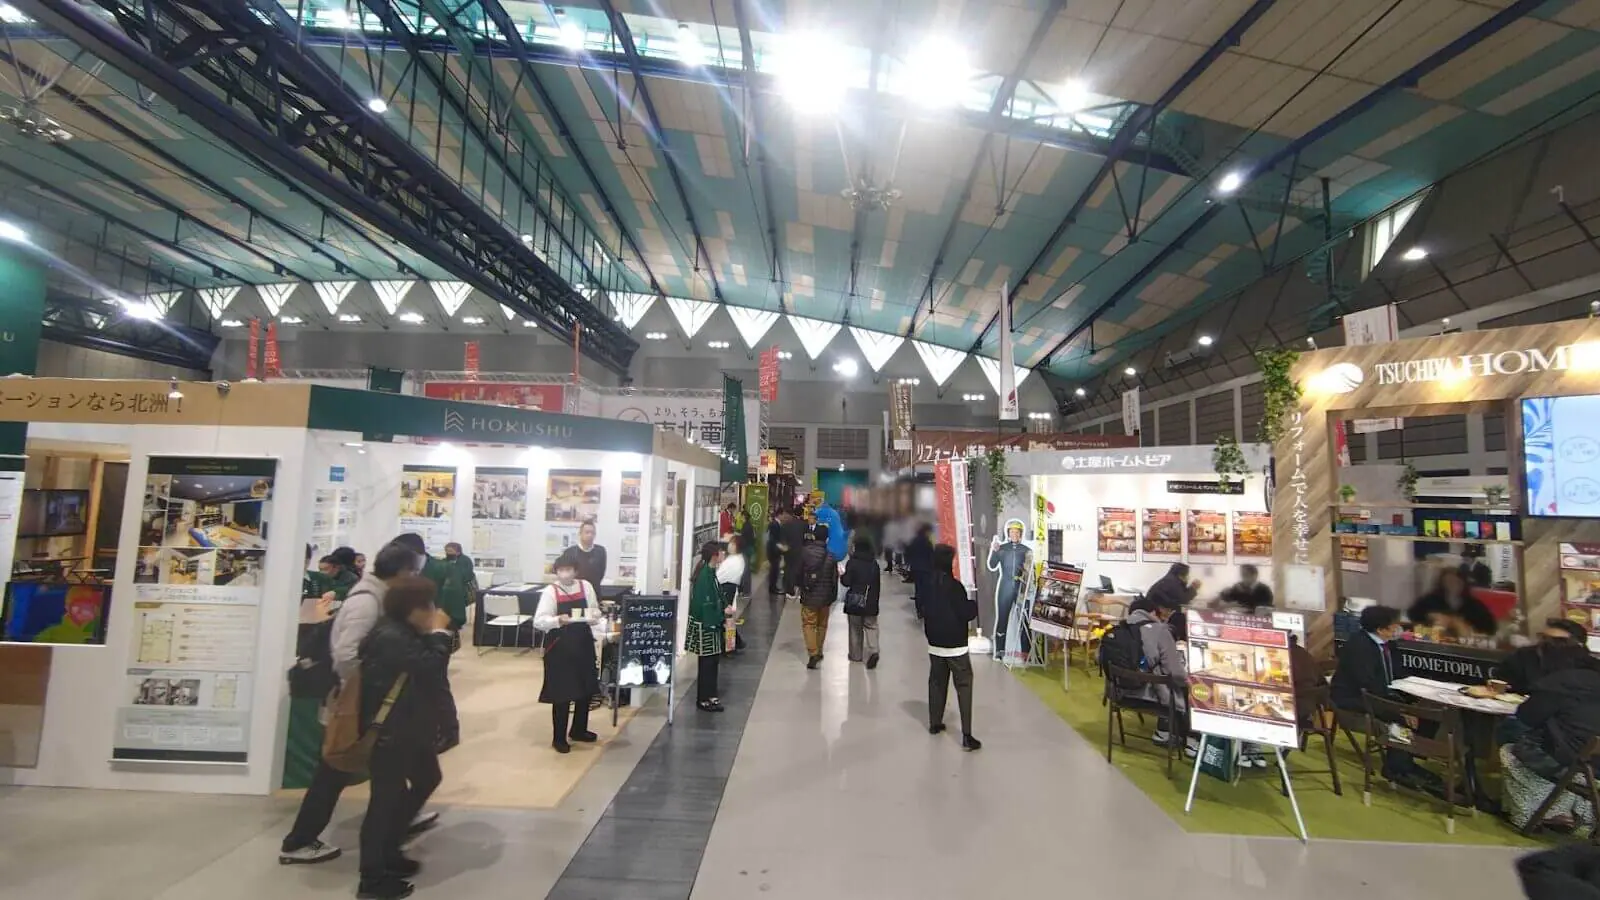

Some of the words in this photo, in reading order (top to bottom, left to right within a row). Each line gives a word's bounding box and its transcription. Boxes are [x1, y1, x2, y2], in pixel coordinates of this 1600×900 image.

[1374, 356, 1455, 385] TSUCHIYA
[1461, 345, 1592, 377] HOM
[0, 390, 184, 414] ーションなら北洲!
[471, 417, 572, 439] HOKUSHU
[1075, 454, 1172, 469] 土屋ホームトピア
[1291, 411, 1310, 564] リフォームで人を幸せに
[1401, 654, 1483, 678] HOMETOPIA
